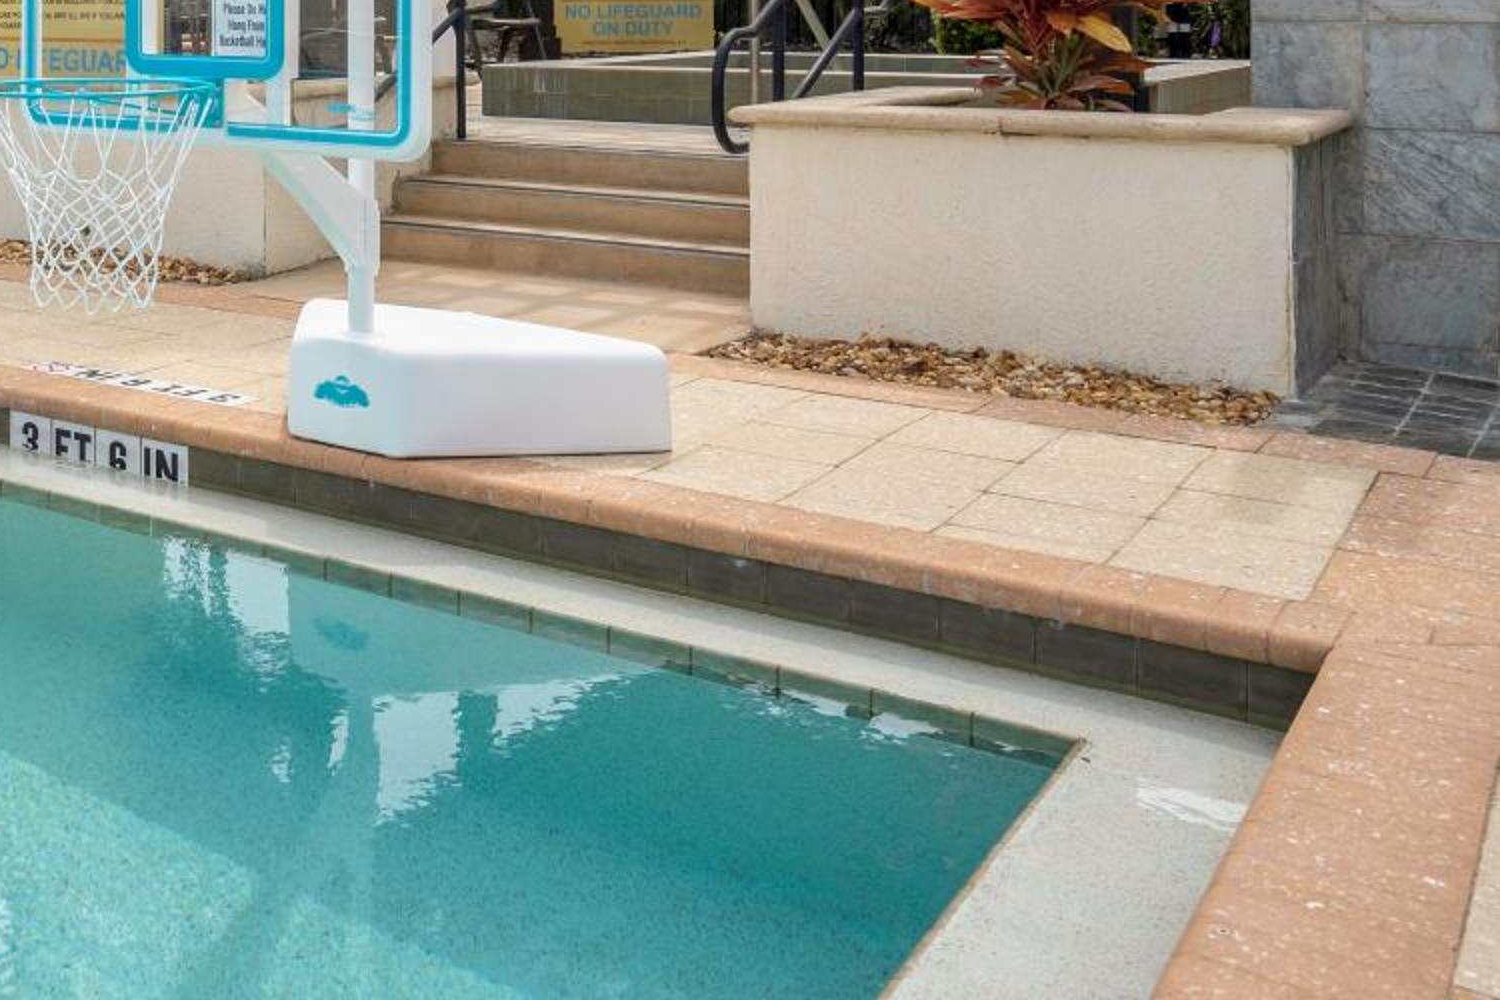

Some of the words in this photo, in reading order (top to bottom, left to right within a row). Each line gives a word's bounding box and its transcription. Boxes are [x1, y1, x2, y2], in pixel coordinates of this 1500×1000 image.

[565, 4, 590, 19] NO
[596, 4, 702, 19] LIFEGUARD
[593, 21, 621, 36] ON
[625, 21, 674, 36] DUTY
[22, 421, 39, 452] 3
[55, 427, 91, 462] FT
[109, 440, 127, 471] 6
[143, 446, 179, 483] IN
